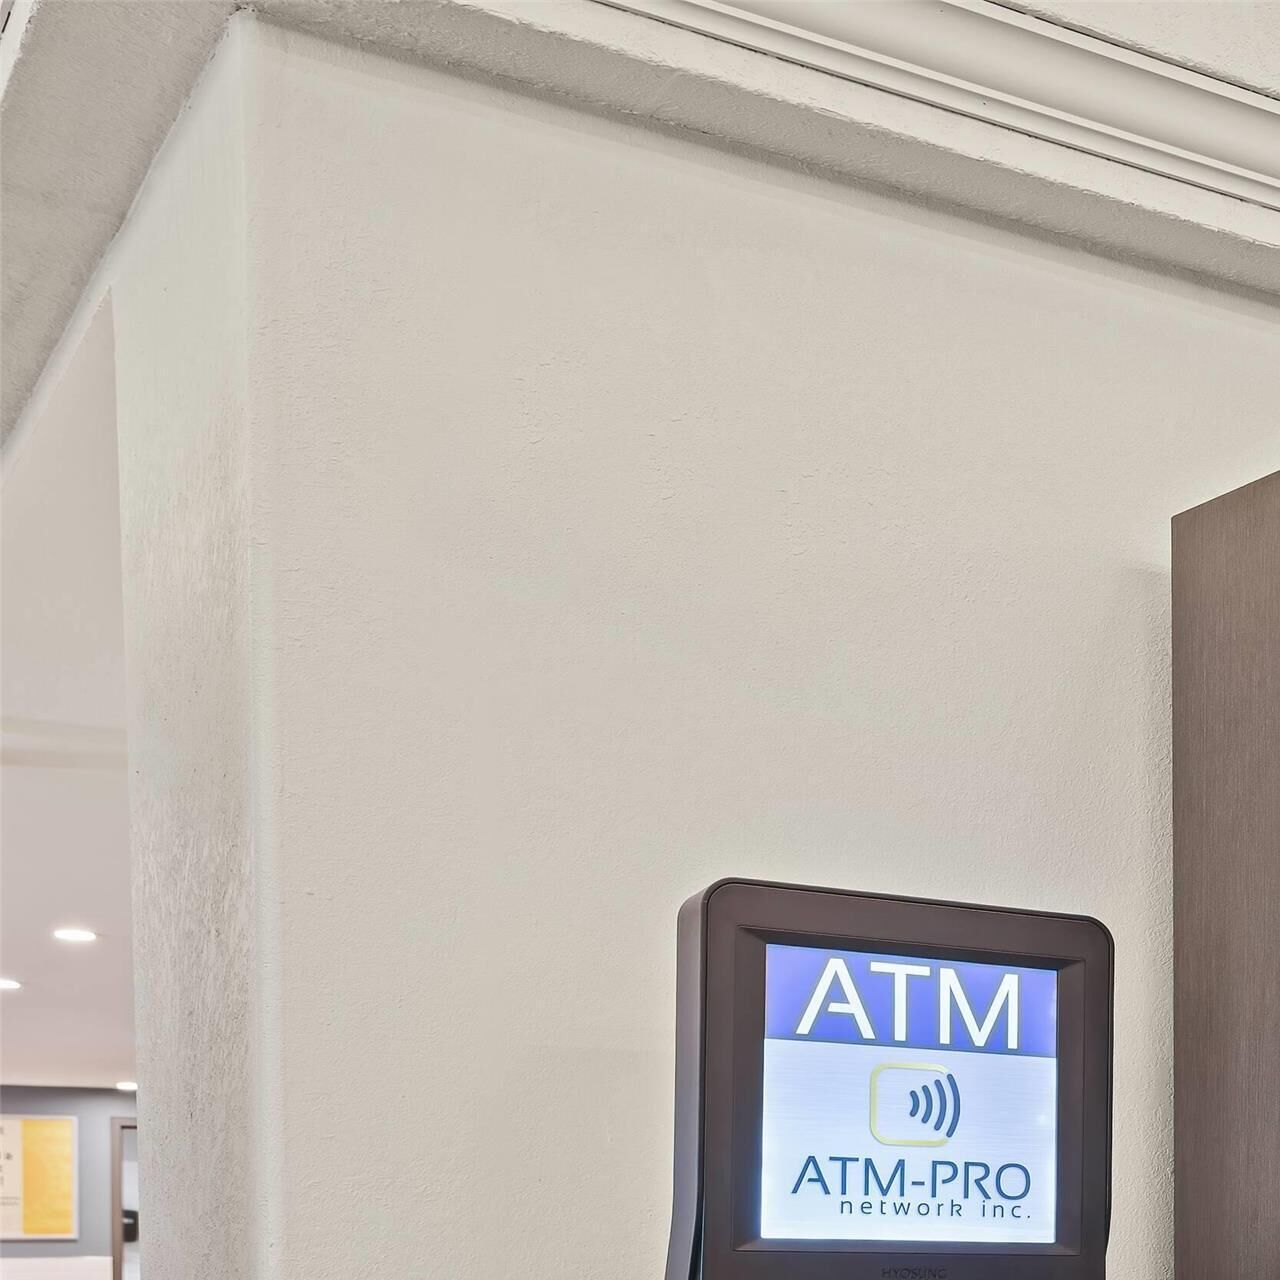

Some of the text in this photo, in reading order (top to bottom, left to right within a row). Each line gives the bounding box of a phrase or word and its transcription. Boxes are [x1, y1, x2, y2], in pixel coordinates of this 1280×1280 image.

[795, 957, 1020, 1050] ATM
[791, 1155, 1032, 1201] ATM-PRO
[840, 1198, 1031, 1219] network inc.
